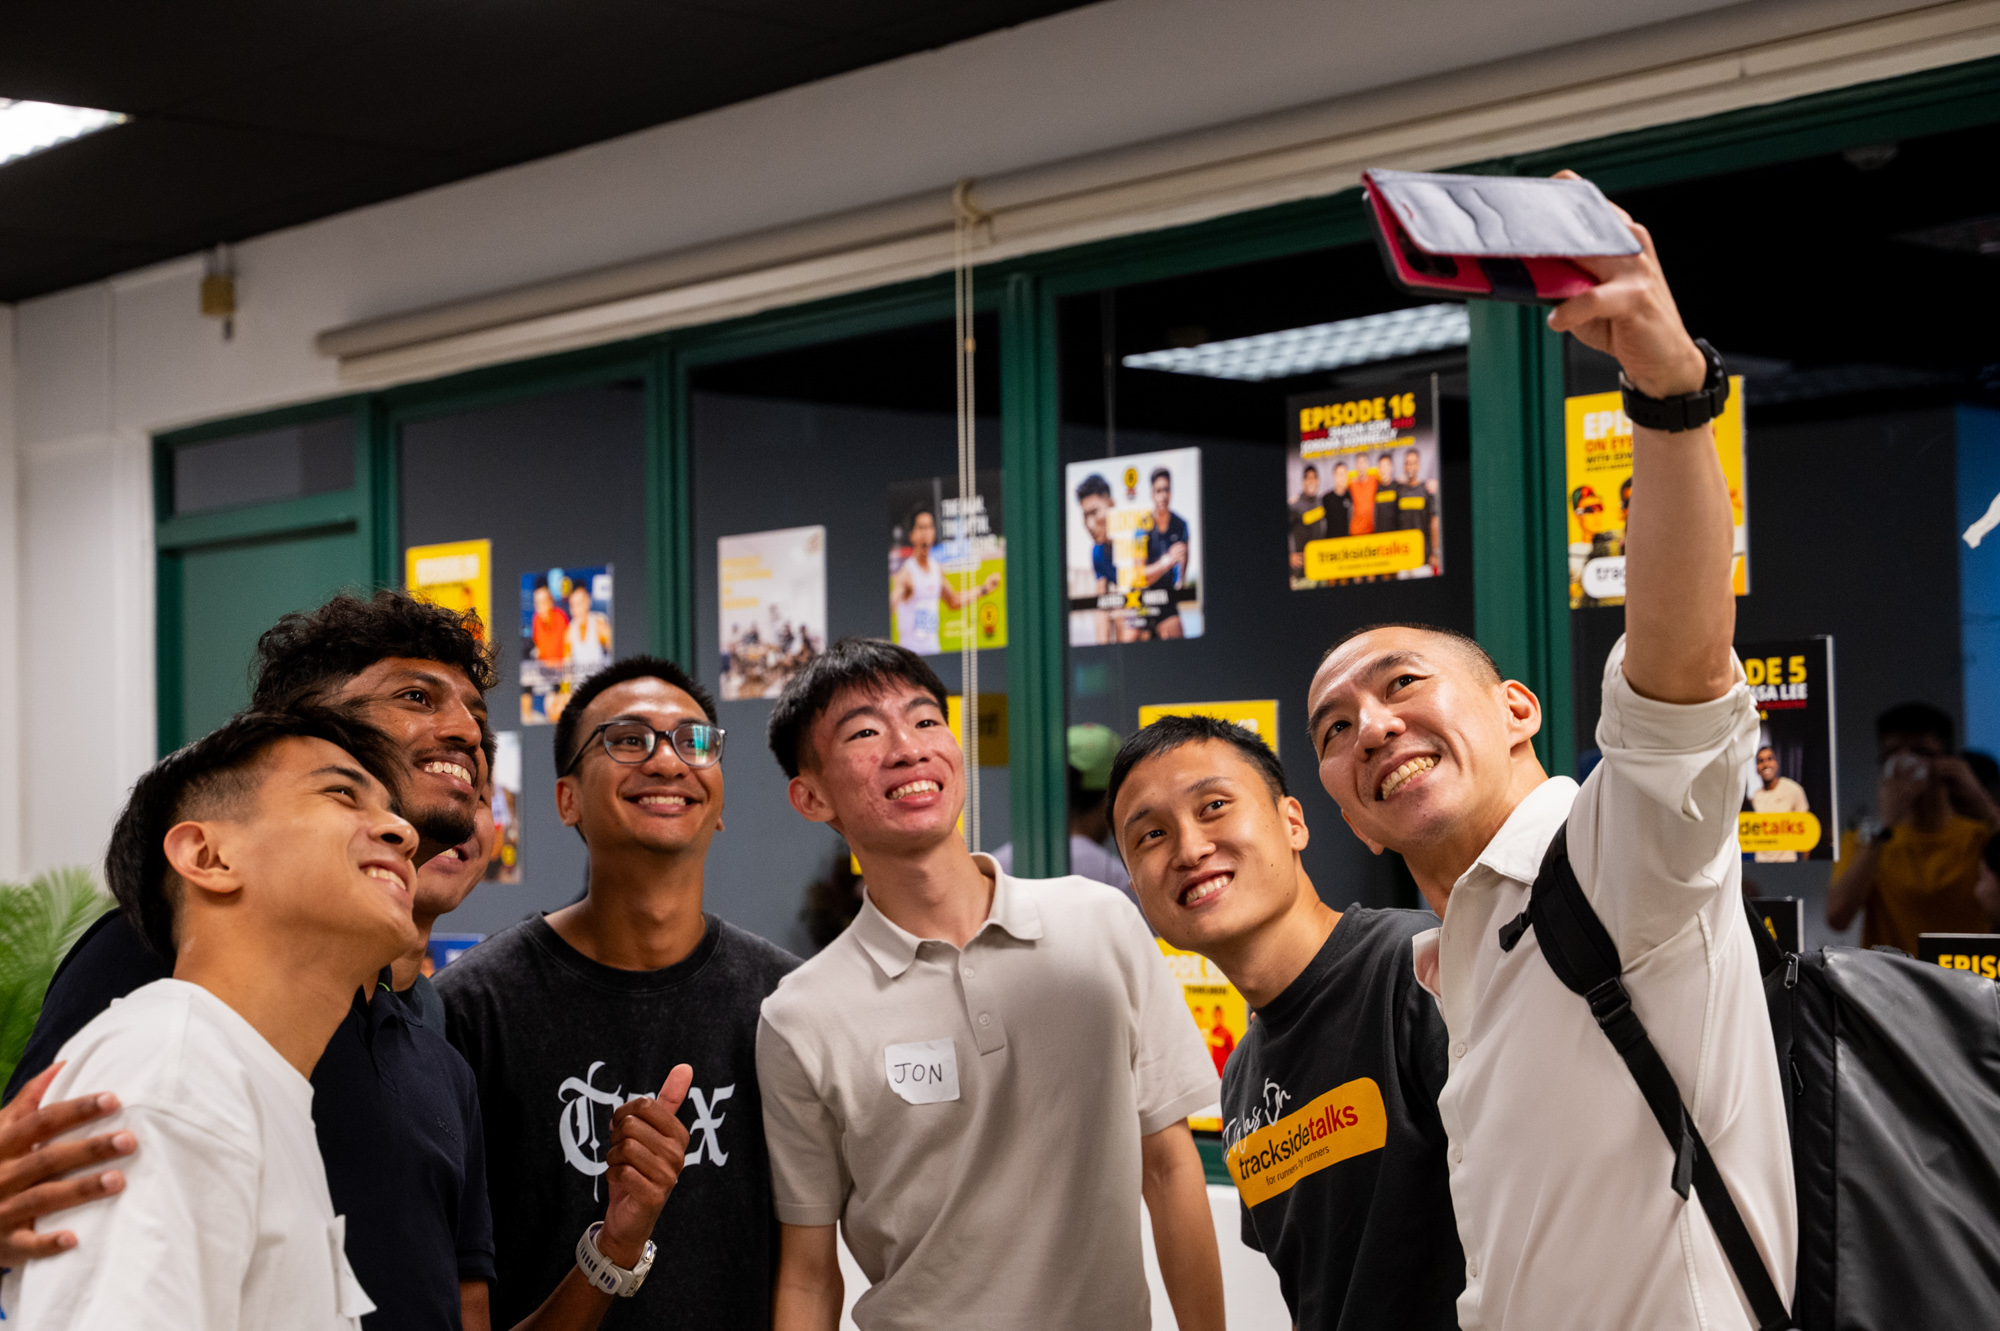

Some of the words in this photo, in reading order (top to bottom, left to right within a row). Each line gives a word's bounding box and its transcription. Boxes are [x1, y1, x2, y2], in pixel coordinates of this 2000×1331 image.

[1299, 396, 1386, 433] EPISODE
[1388, 391, 1416, 419] 16
[1583, 408, 1633, 440] EPIS
[1585, 440, 1606, 453] ON
[1611, 435, 1633, 451] EYE
[1740, 657, 1782, 686] DE
[1788, 655, 1807, 684] 5
[1749, 684, 1779, 702] SSA
[1780, 682, 1808, 701] LEE
[1739, 818, 1805, 836] detalks
[1938, 954, 2000, 980] EPIS
[894, 1062, 943, 1085] JON
[1239, 1103, 1359, 1181] tracksidetalks
[1265, 1174, 1276, 1186] for
[1276, 1161, 1299, 1183] runners
[1303, 1145, 1330, 1164] runners
